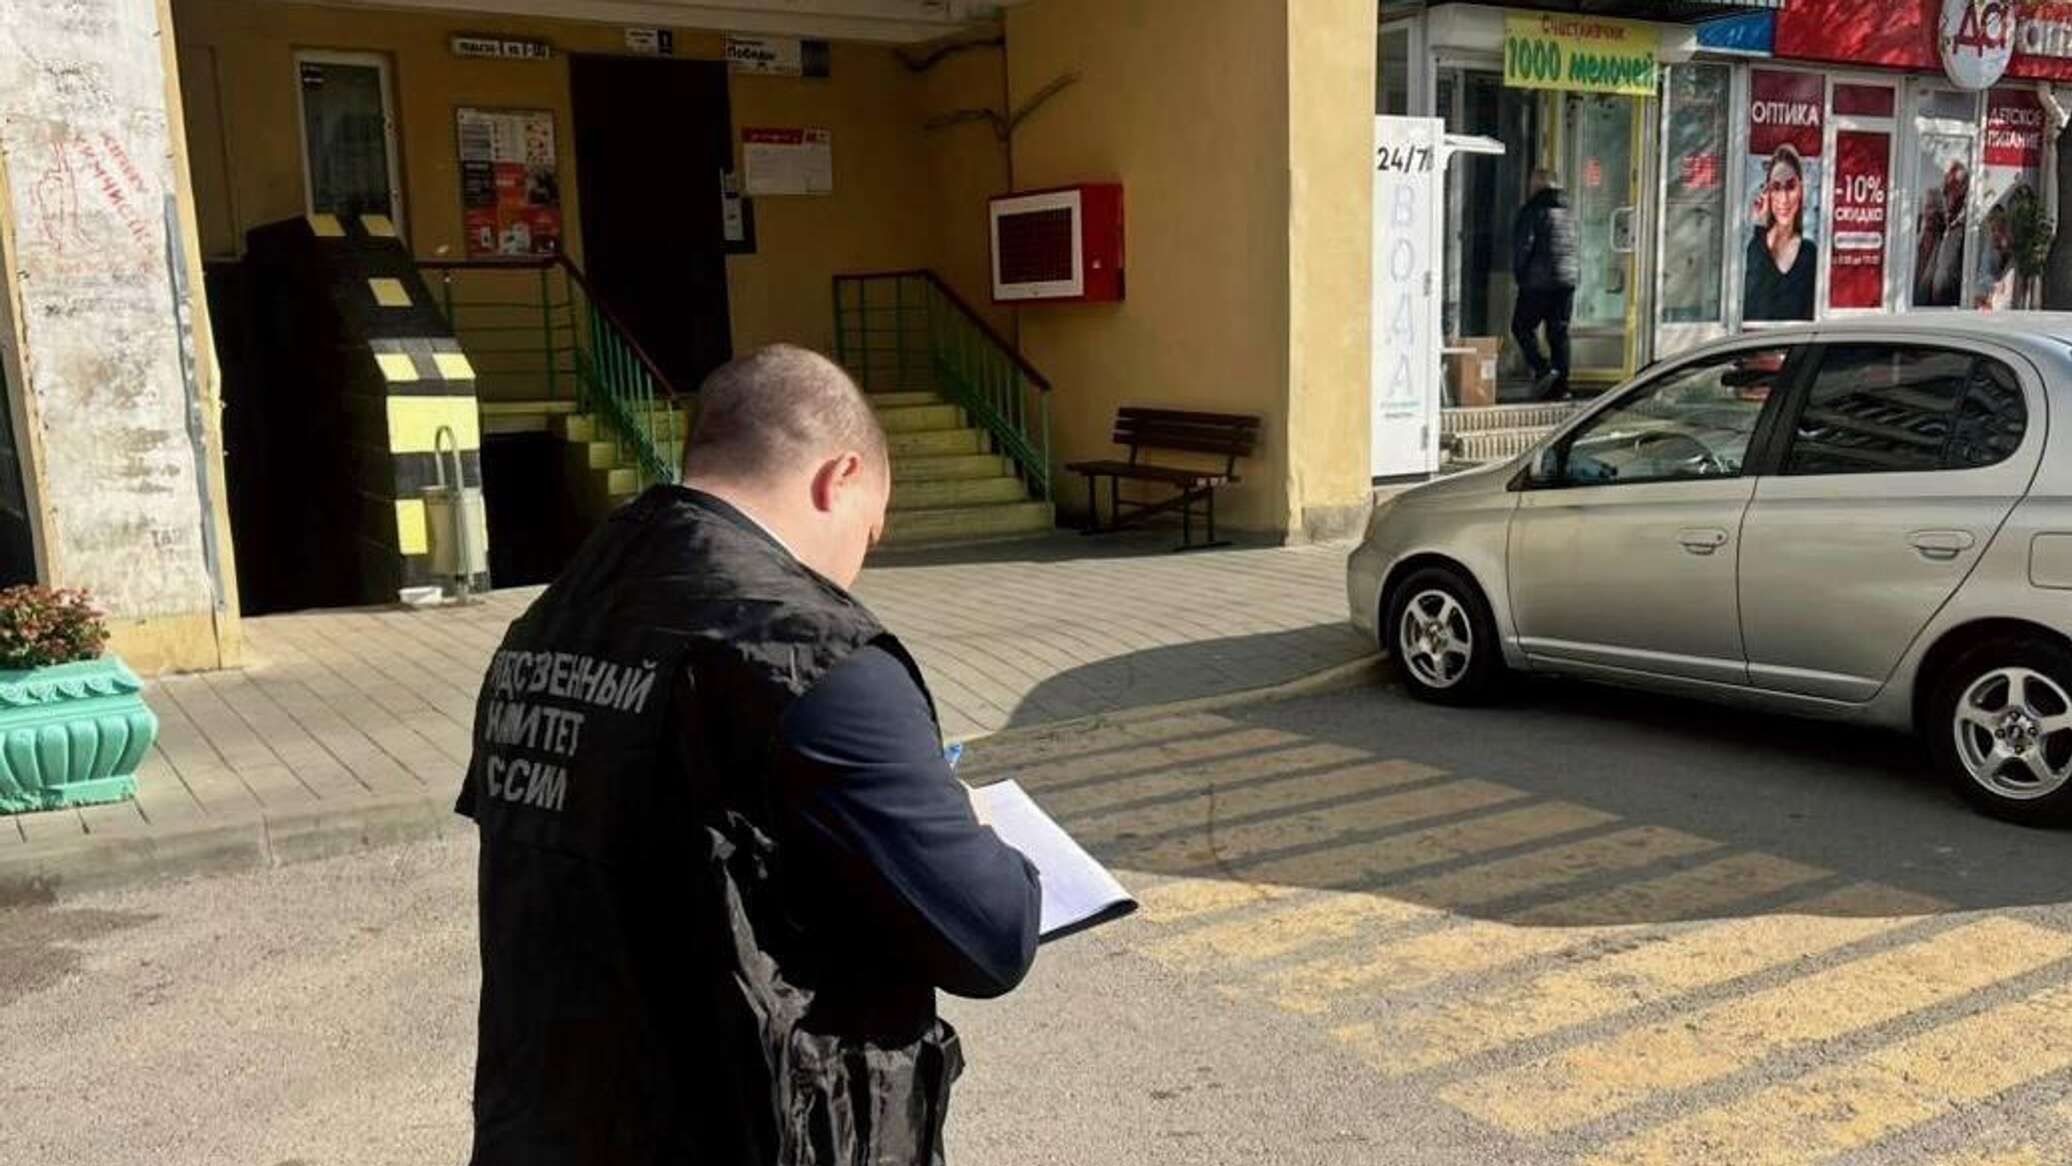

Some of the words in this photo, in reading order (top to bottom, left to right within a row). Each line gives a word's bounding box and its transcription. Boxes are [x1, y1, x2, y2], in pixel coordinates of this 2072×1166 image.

[1508, 36, 1561, 81] 1000
[1752, 101, 1820, 127] ОПТИКА
[1377, 145, 1429, 174] 24/7
[1835, 174, 1886, 204] -10%
